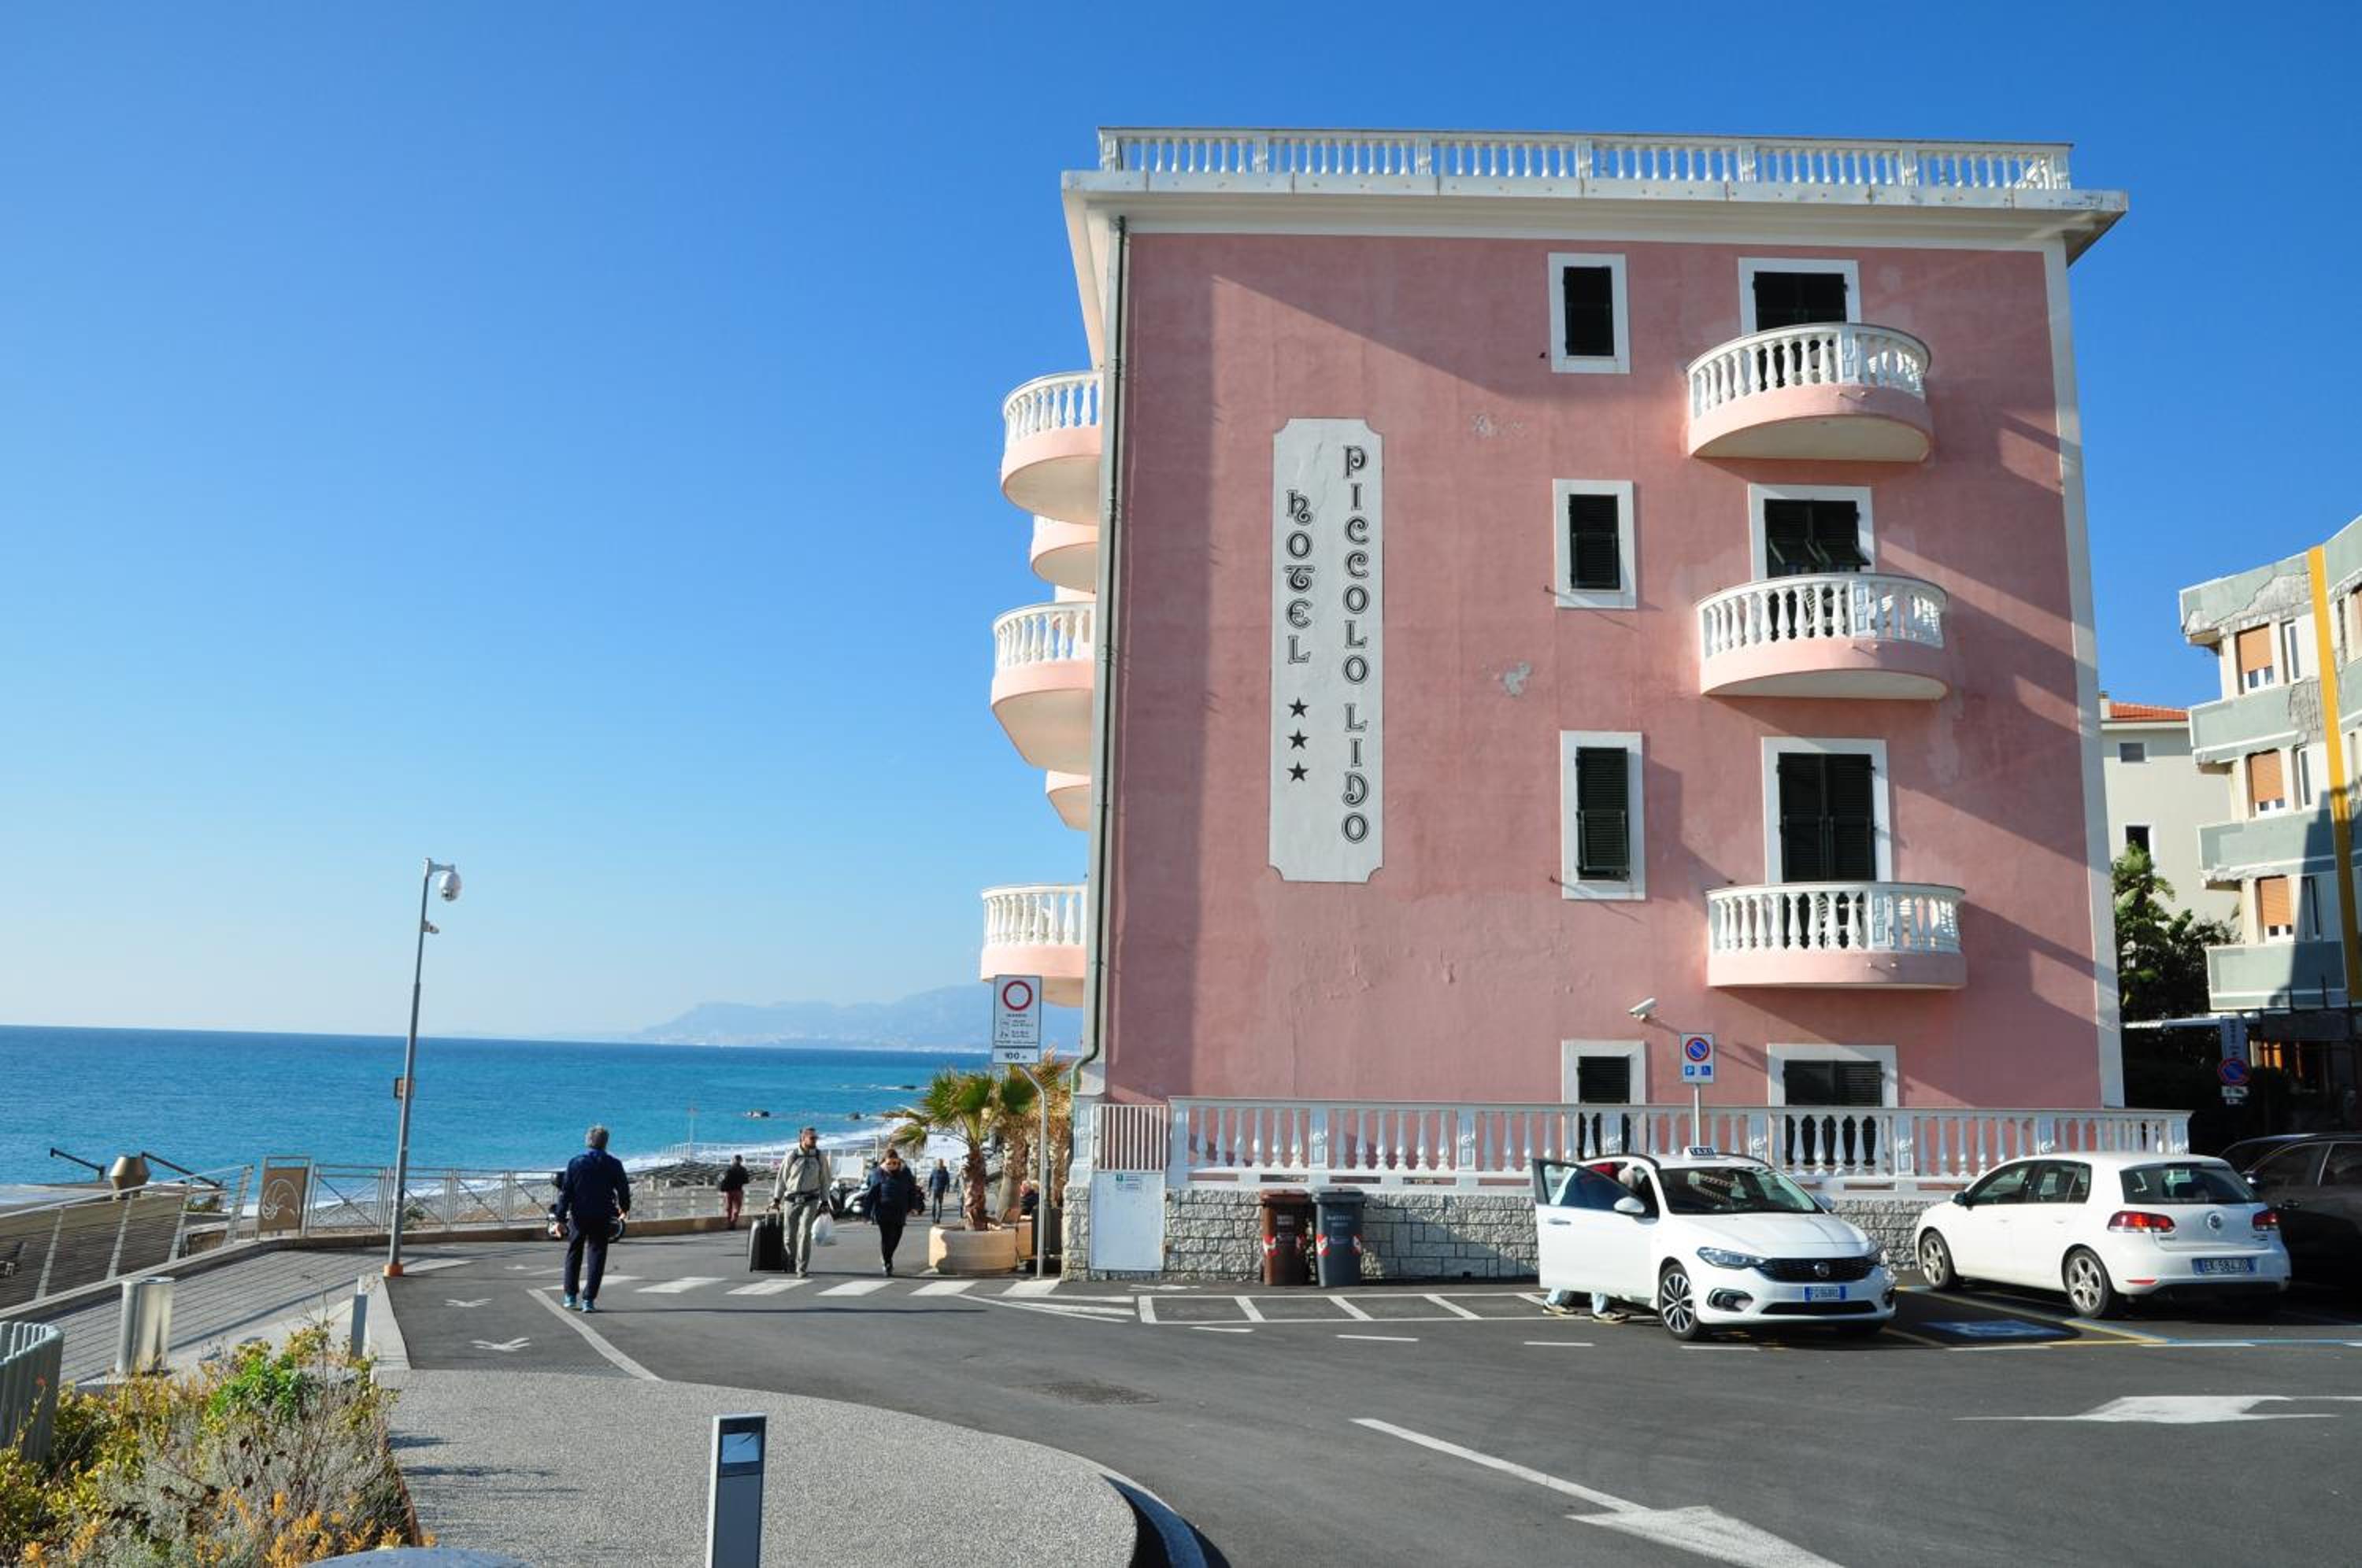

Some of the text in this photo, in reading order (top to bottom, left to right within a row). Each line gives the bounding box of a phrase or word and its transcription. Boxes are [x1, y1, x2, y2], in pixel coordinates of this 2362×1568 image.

[1284, 489, 1316, 665] HOTEL
[1341, 445, 1371, 845] PICCOLO LIDO
